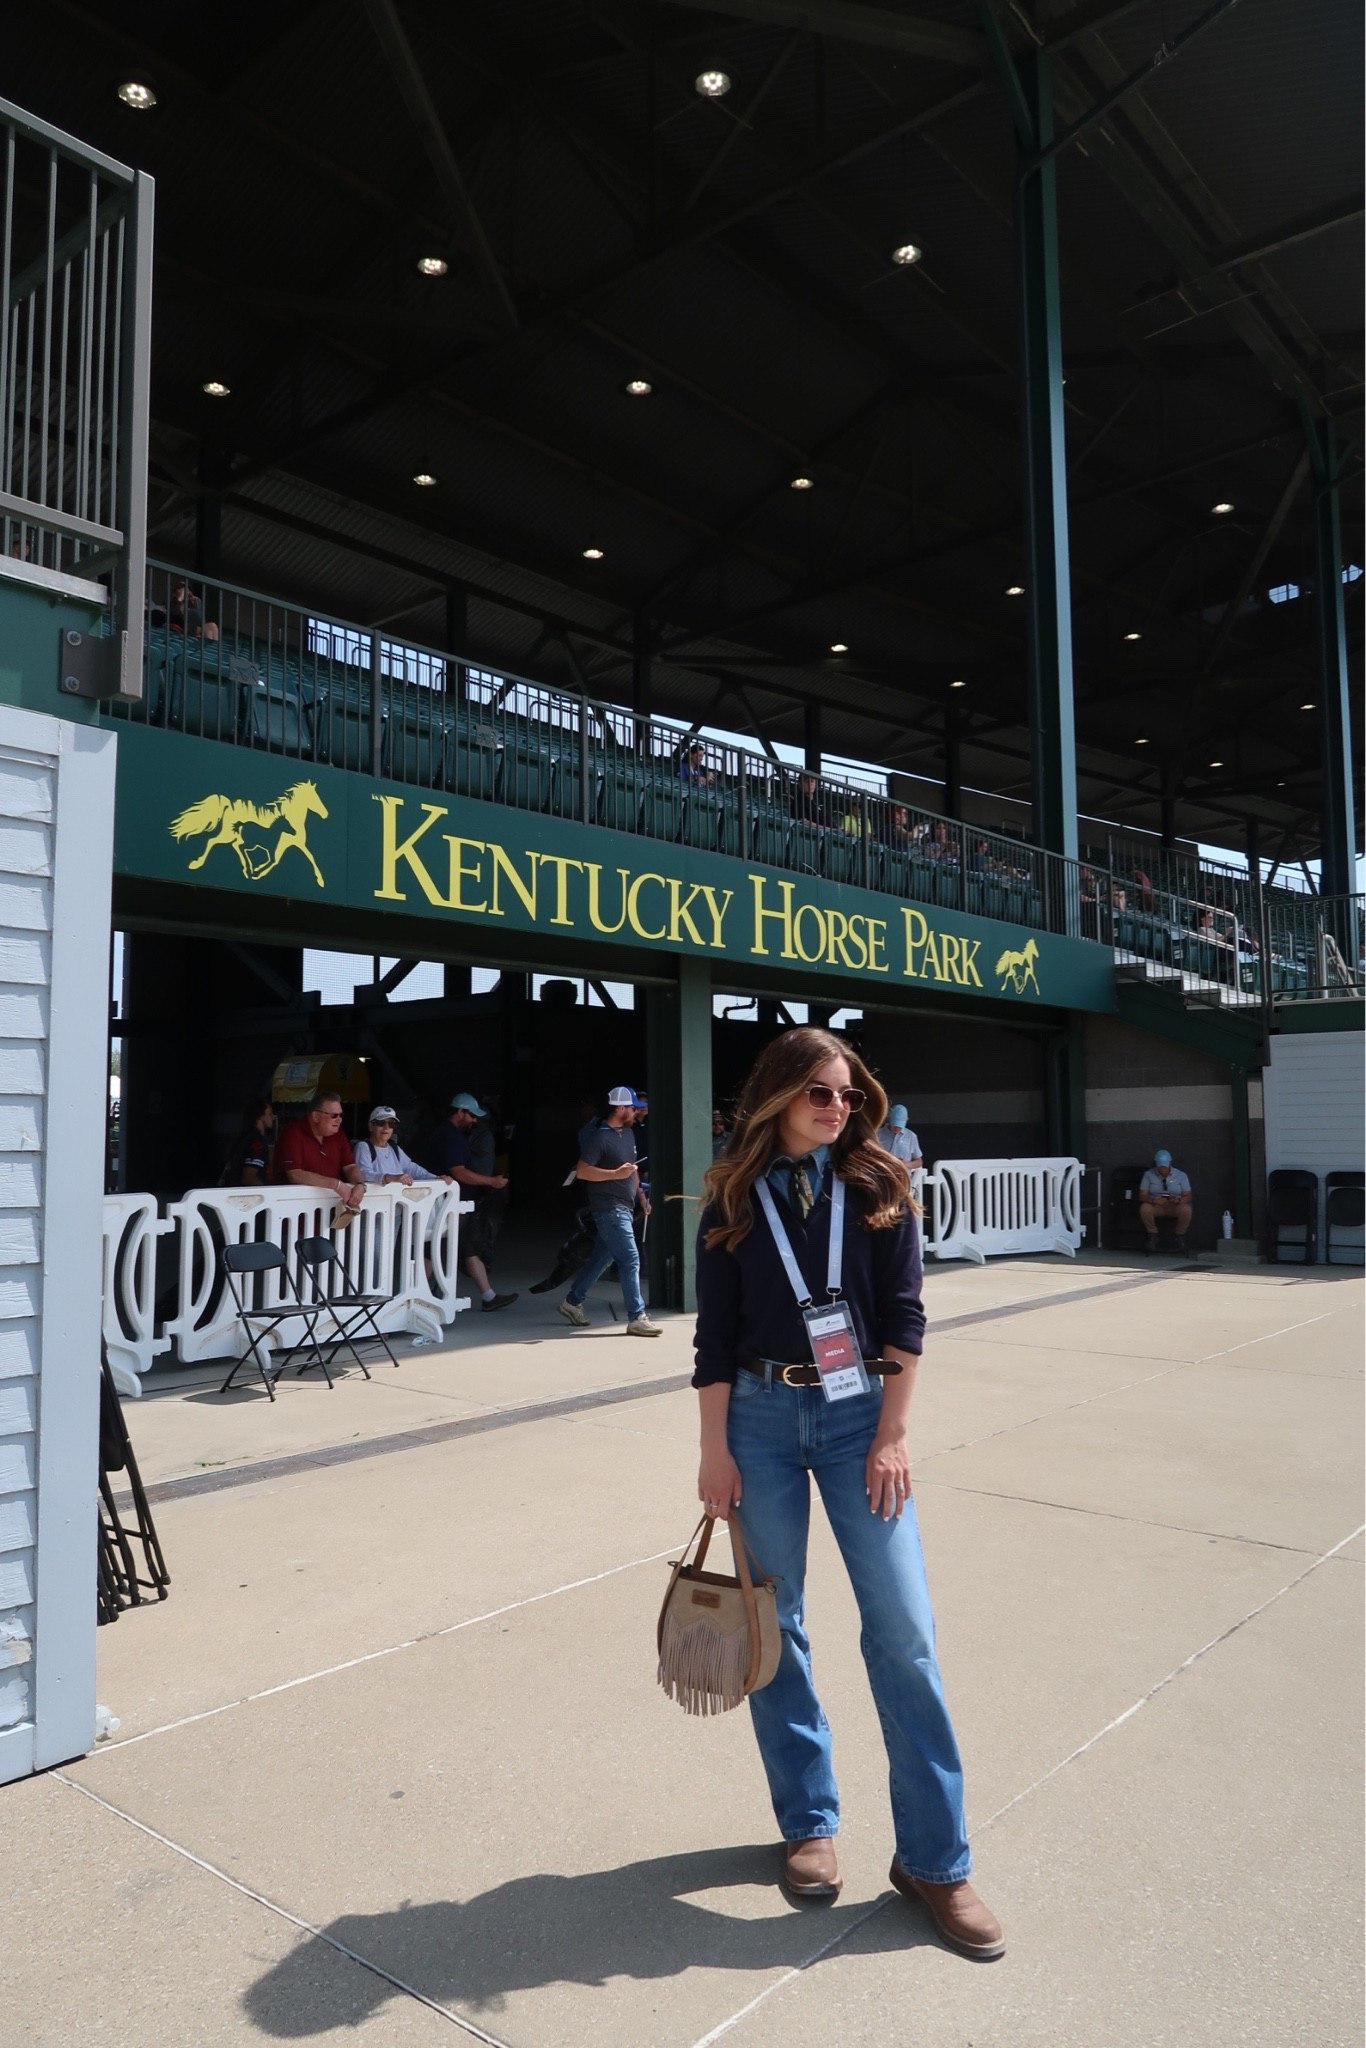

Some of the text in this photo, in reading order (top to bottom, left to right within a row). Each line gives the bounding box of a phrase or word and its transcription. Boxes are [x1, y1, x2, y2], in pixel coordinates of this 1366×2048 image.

[371, 794, 983, 987] KENTUCKY HORSE PARK
[825, 1348, 845, 1357] MEDIA
